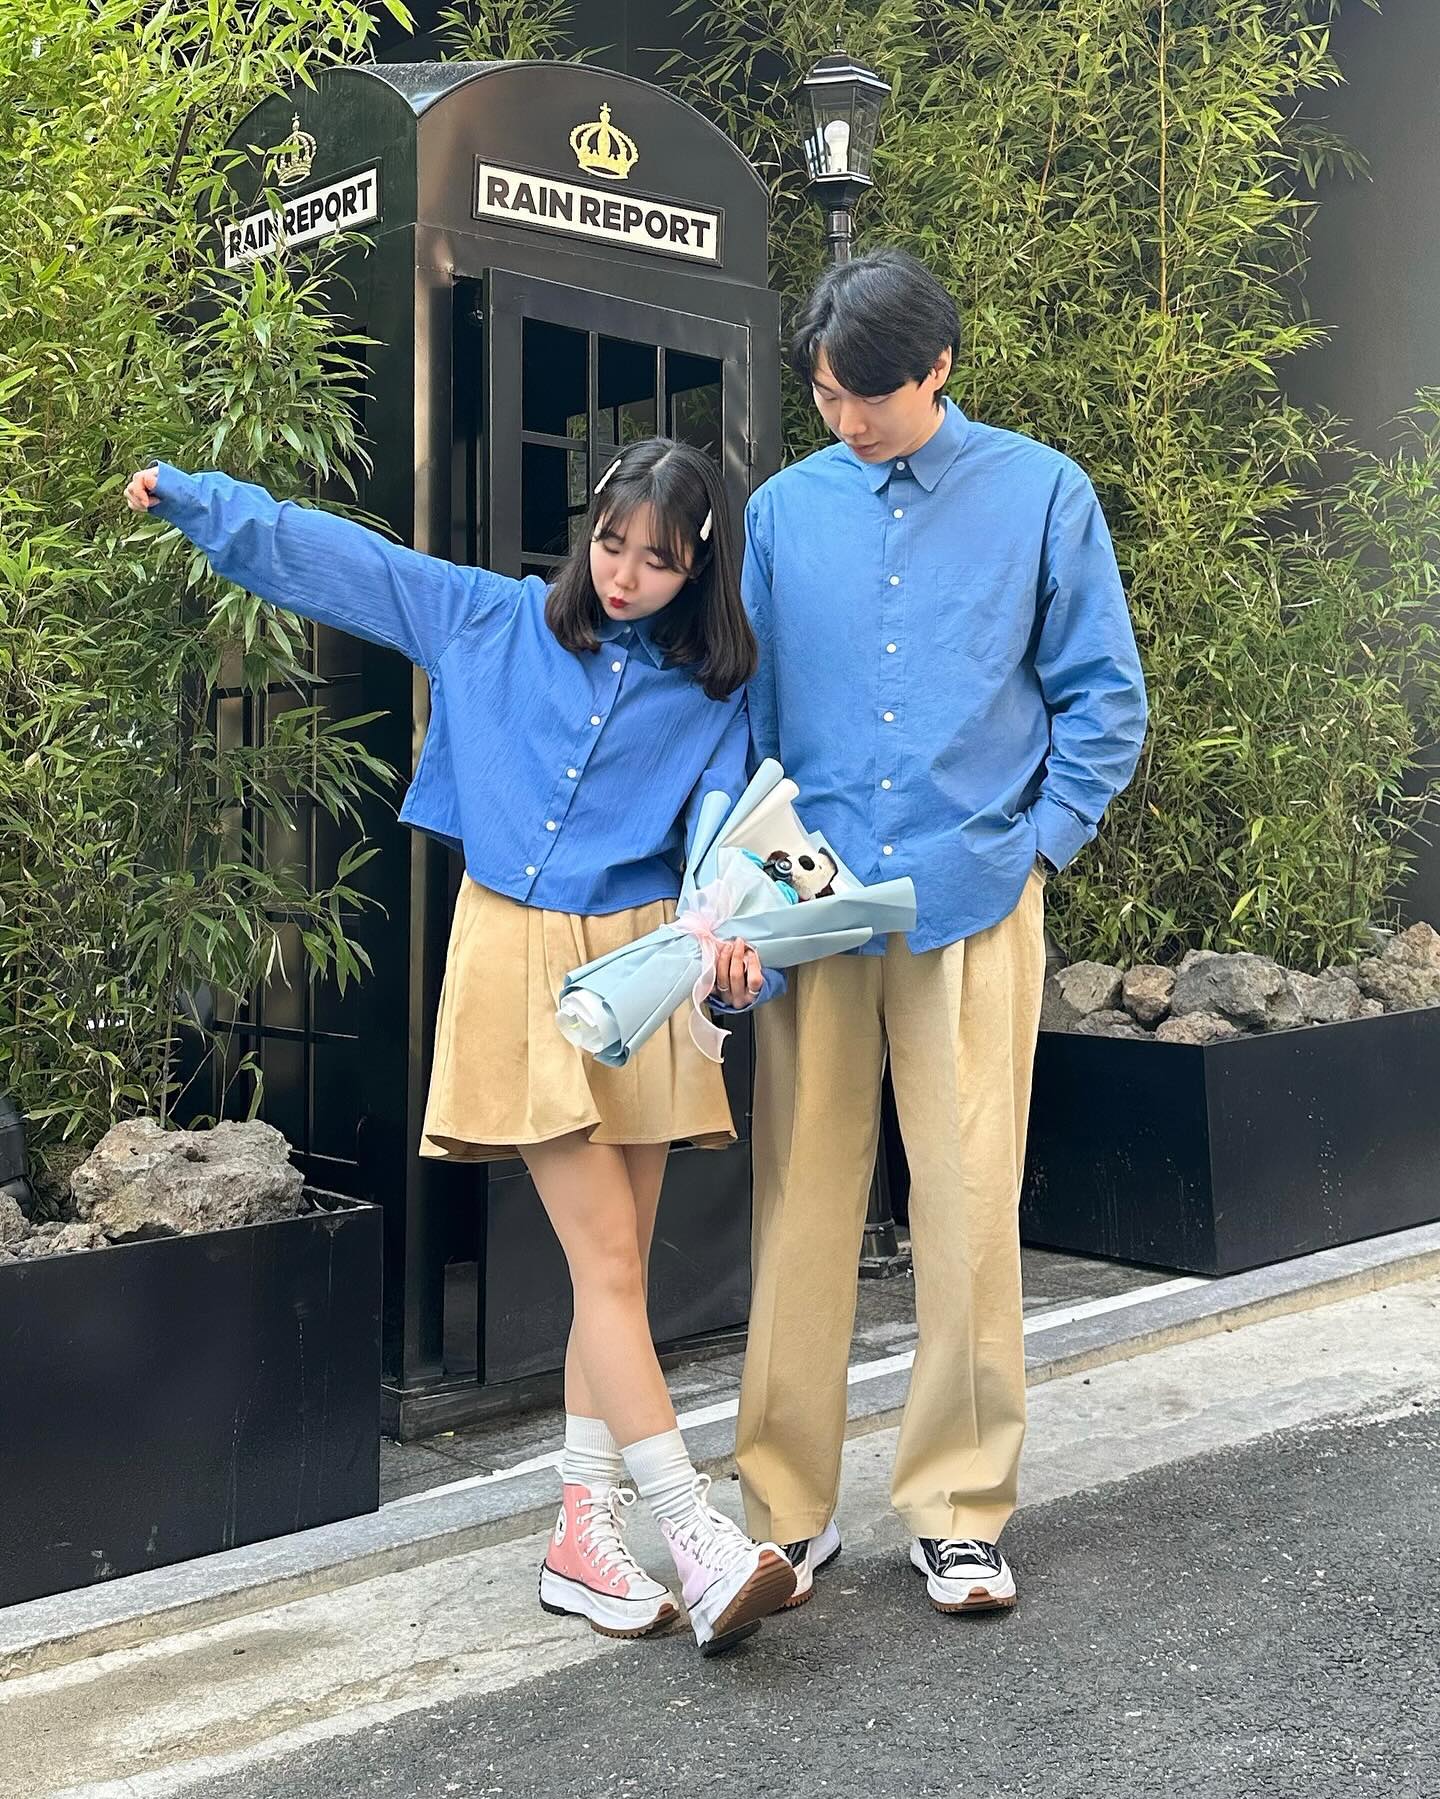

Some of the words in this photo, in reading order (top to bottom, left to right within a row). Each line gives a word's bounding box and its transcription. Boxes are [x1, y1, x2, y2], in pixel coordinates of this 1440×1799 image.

[283, 179, 372, 236] REPORT
[487, 176, 573, 221] RAIN
[580, 195, 710, 248] REPORT
